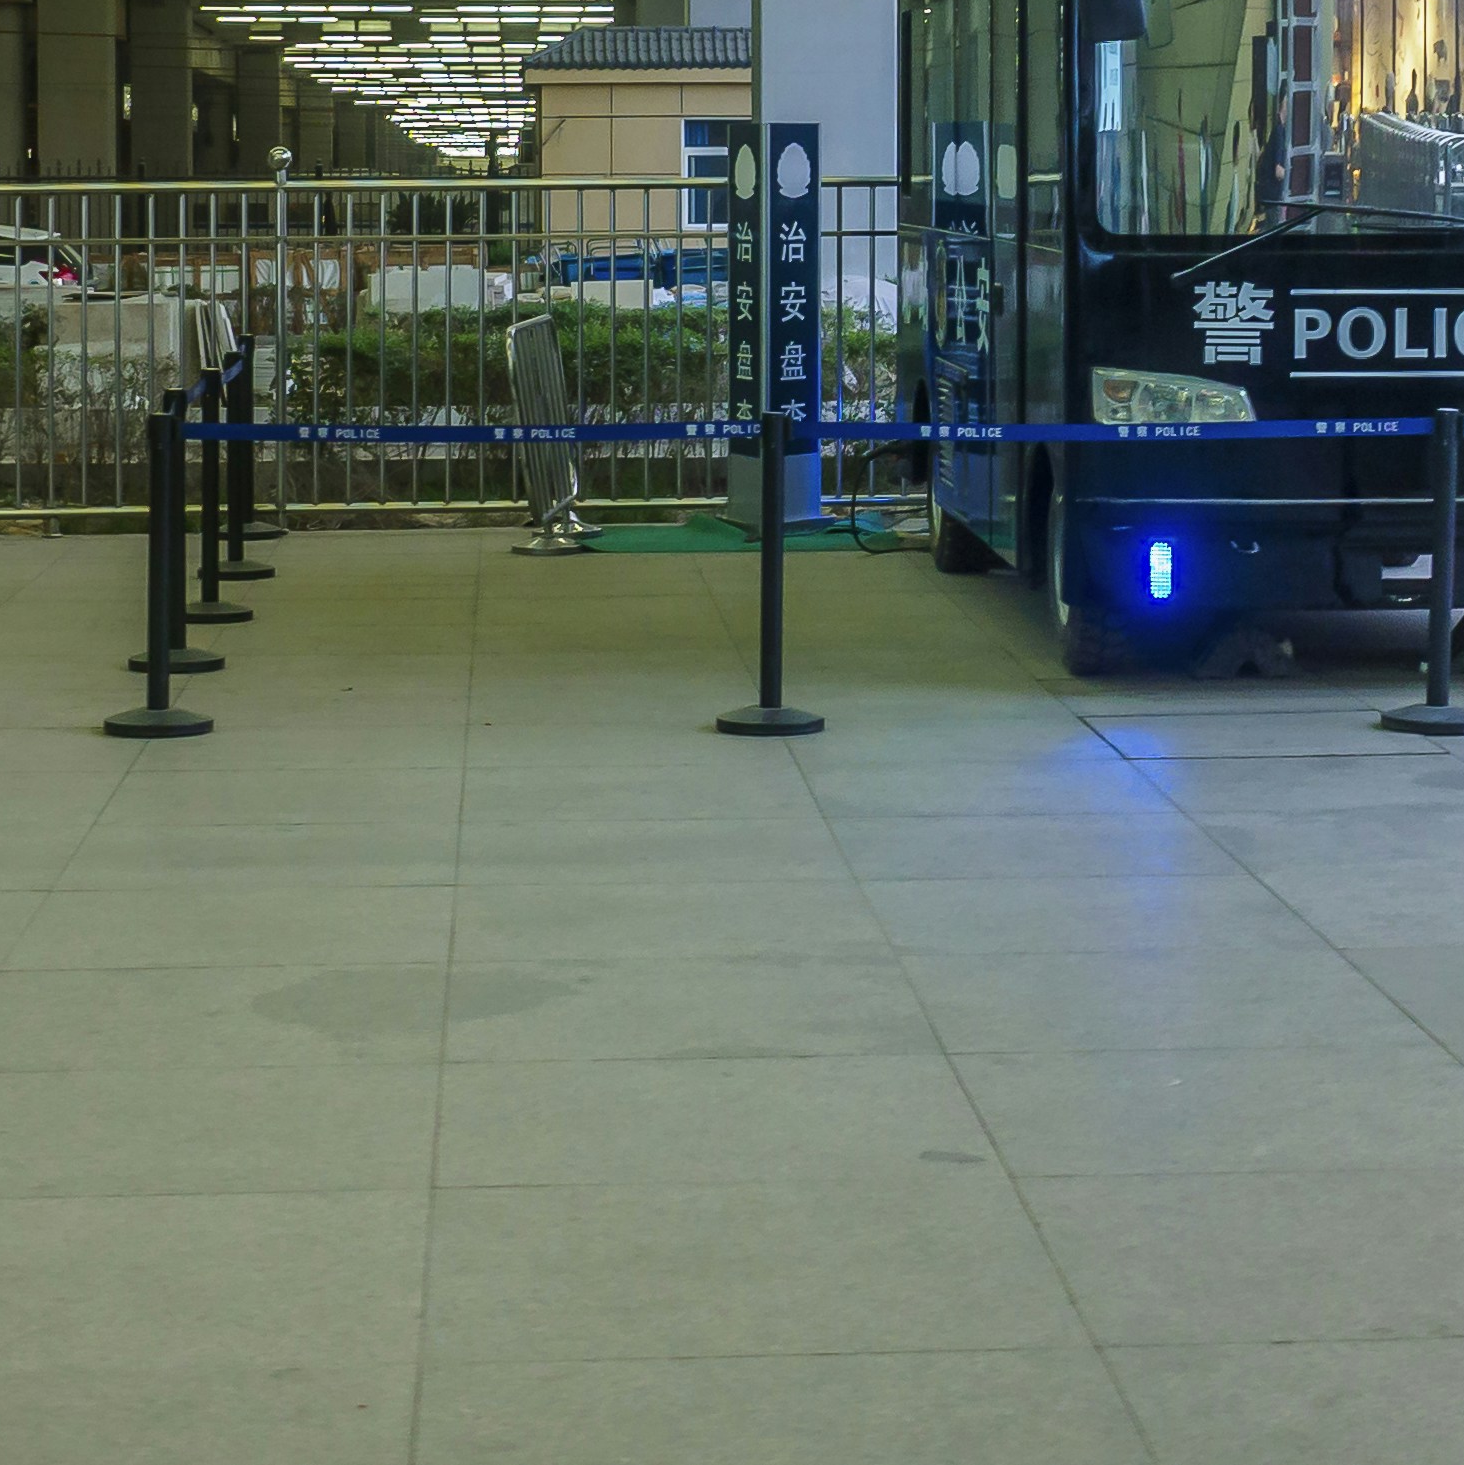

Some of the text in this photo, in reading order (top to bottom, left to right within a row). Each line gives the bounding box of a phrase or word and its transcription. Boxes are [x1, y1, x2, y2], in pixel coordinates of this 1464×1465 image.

[1193, 281, 1274, 365] 警
[335, 427, 380, 439] POLICE
[530, 427, 576, 439] POLICE
[722, 423, 761, 435] POLIC
[957, 426, 1003, 438] POLICE
[1155, 425, 1201, 437] POLICE
[1353, 421, 1399, 433] POLICE
